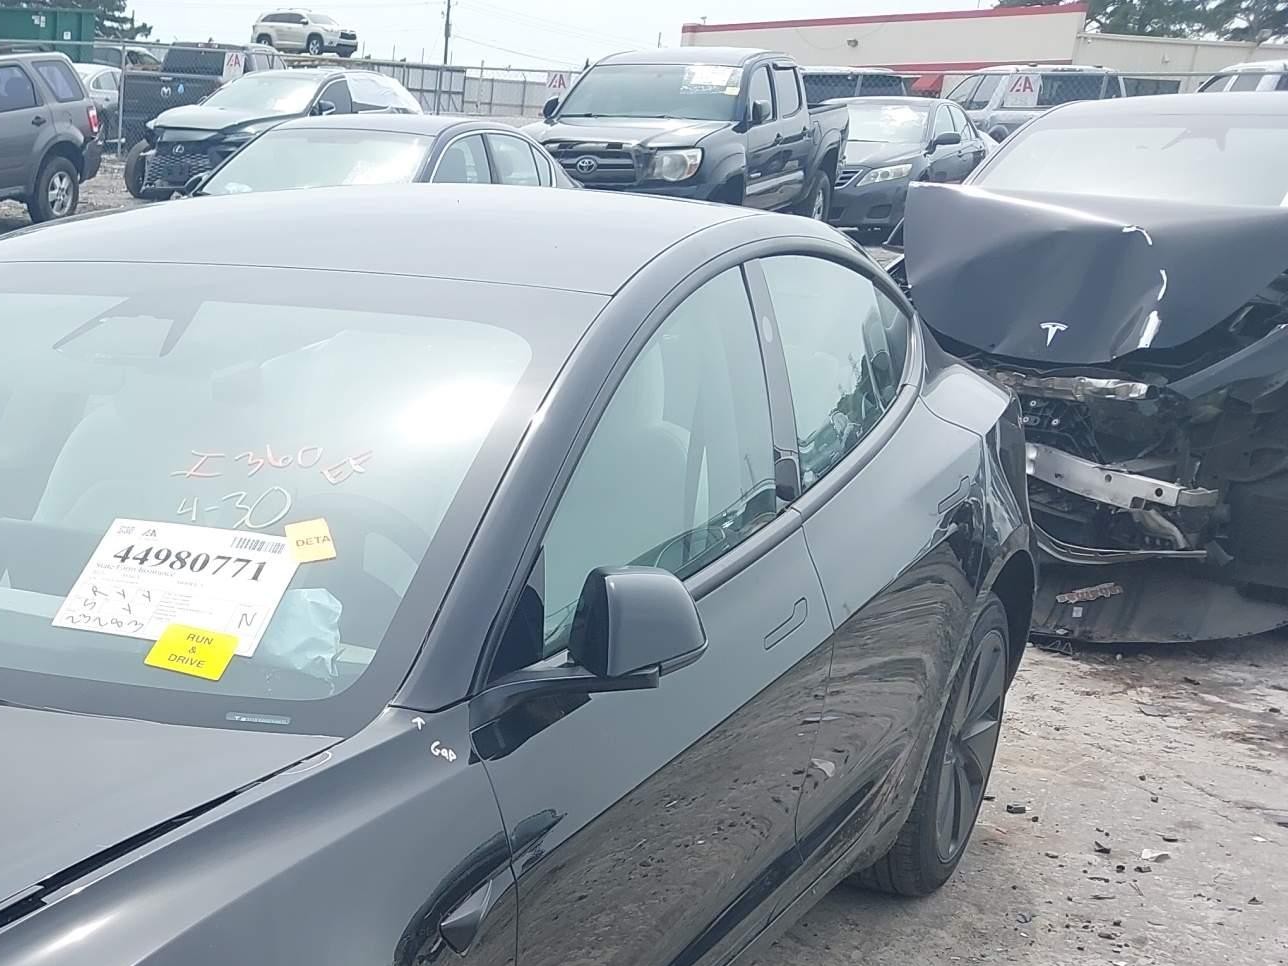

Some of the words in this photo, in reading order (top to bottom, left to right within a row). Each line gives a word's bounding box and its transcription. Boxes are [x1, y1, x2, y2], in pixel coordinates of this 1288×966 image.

[176, 486, 292, 529] 4-30
[113, 544, 268, 582] 44980771
[186, 633, 214, 646] RUN
[188, 645, 197, 655] &
[167, 652, 207, 669] DRIVE
[430, 740, 457, 762] Gap
